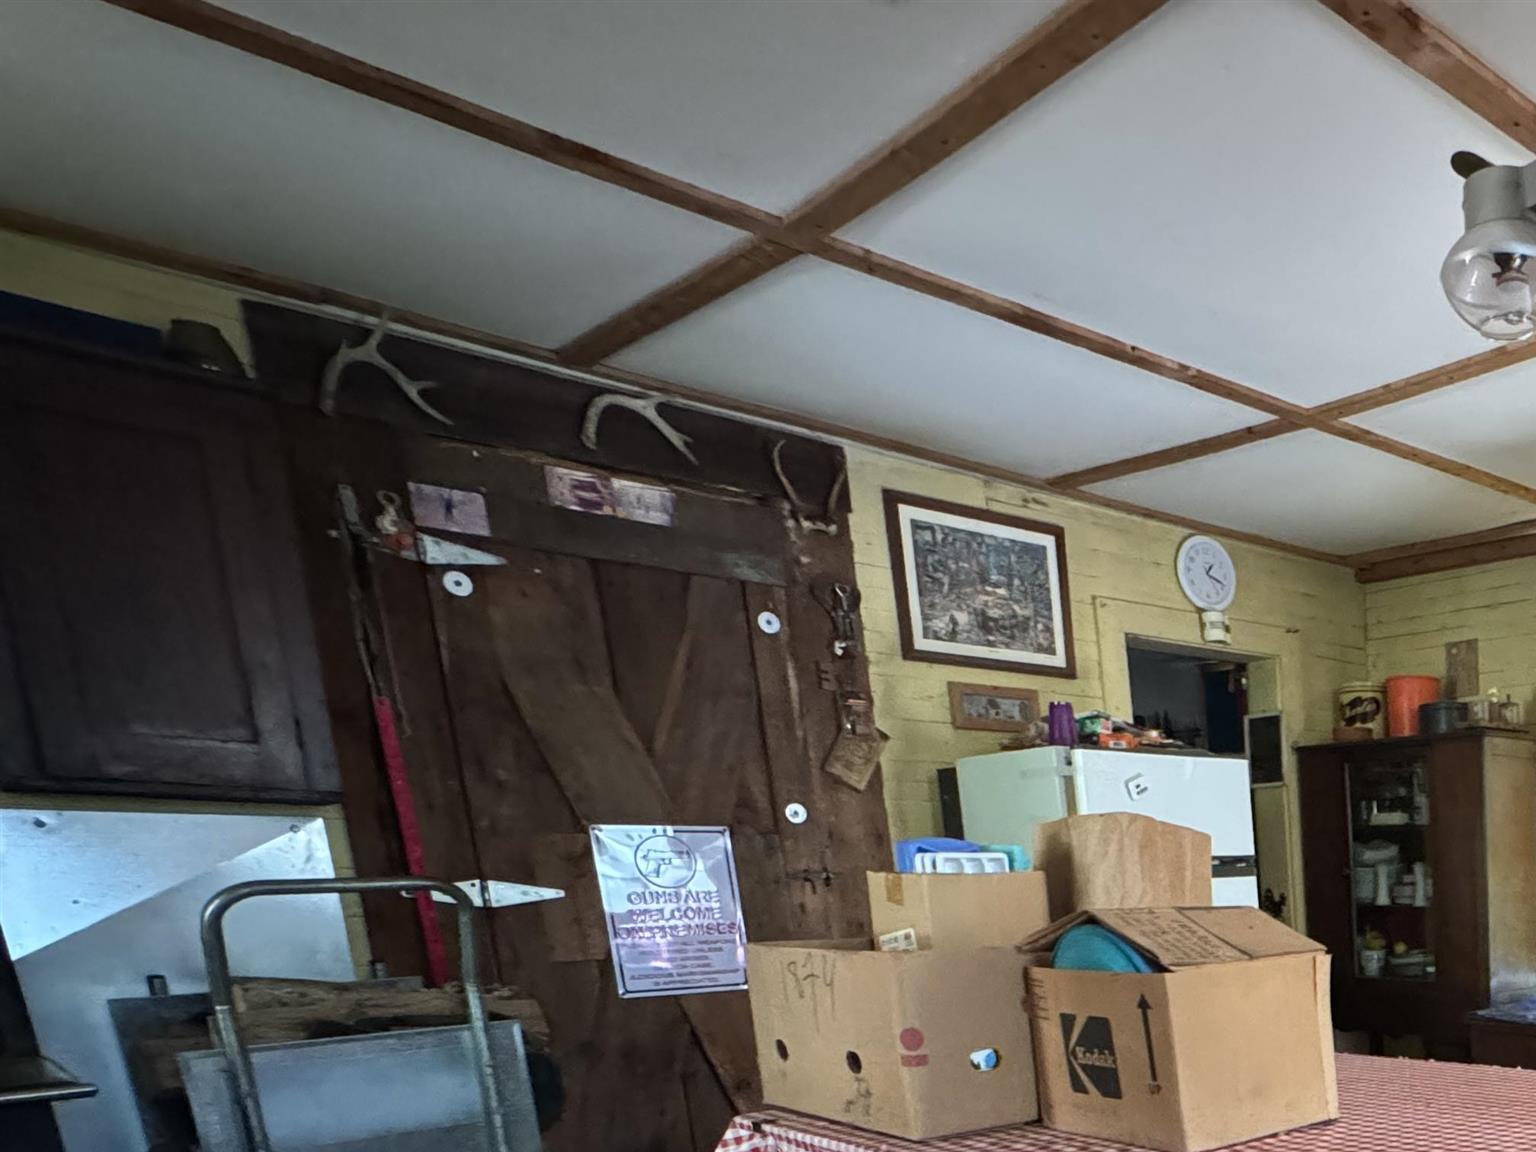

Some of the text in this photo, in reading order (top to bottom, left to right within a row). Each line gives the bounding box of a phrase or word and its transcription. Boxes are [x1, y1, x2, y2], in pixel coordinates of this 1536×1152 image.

[626, 888, 721, 905] GUNS ARE
[626, 905, 723, 923] WELCOME
[1075, 1046, 1117, 1068] Kodak
